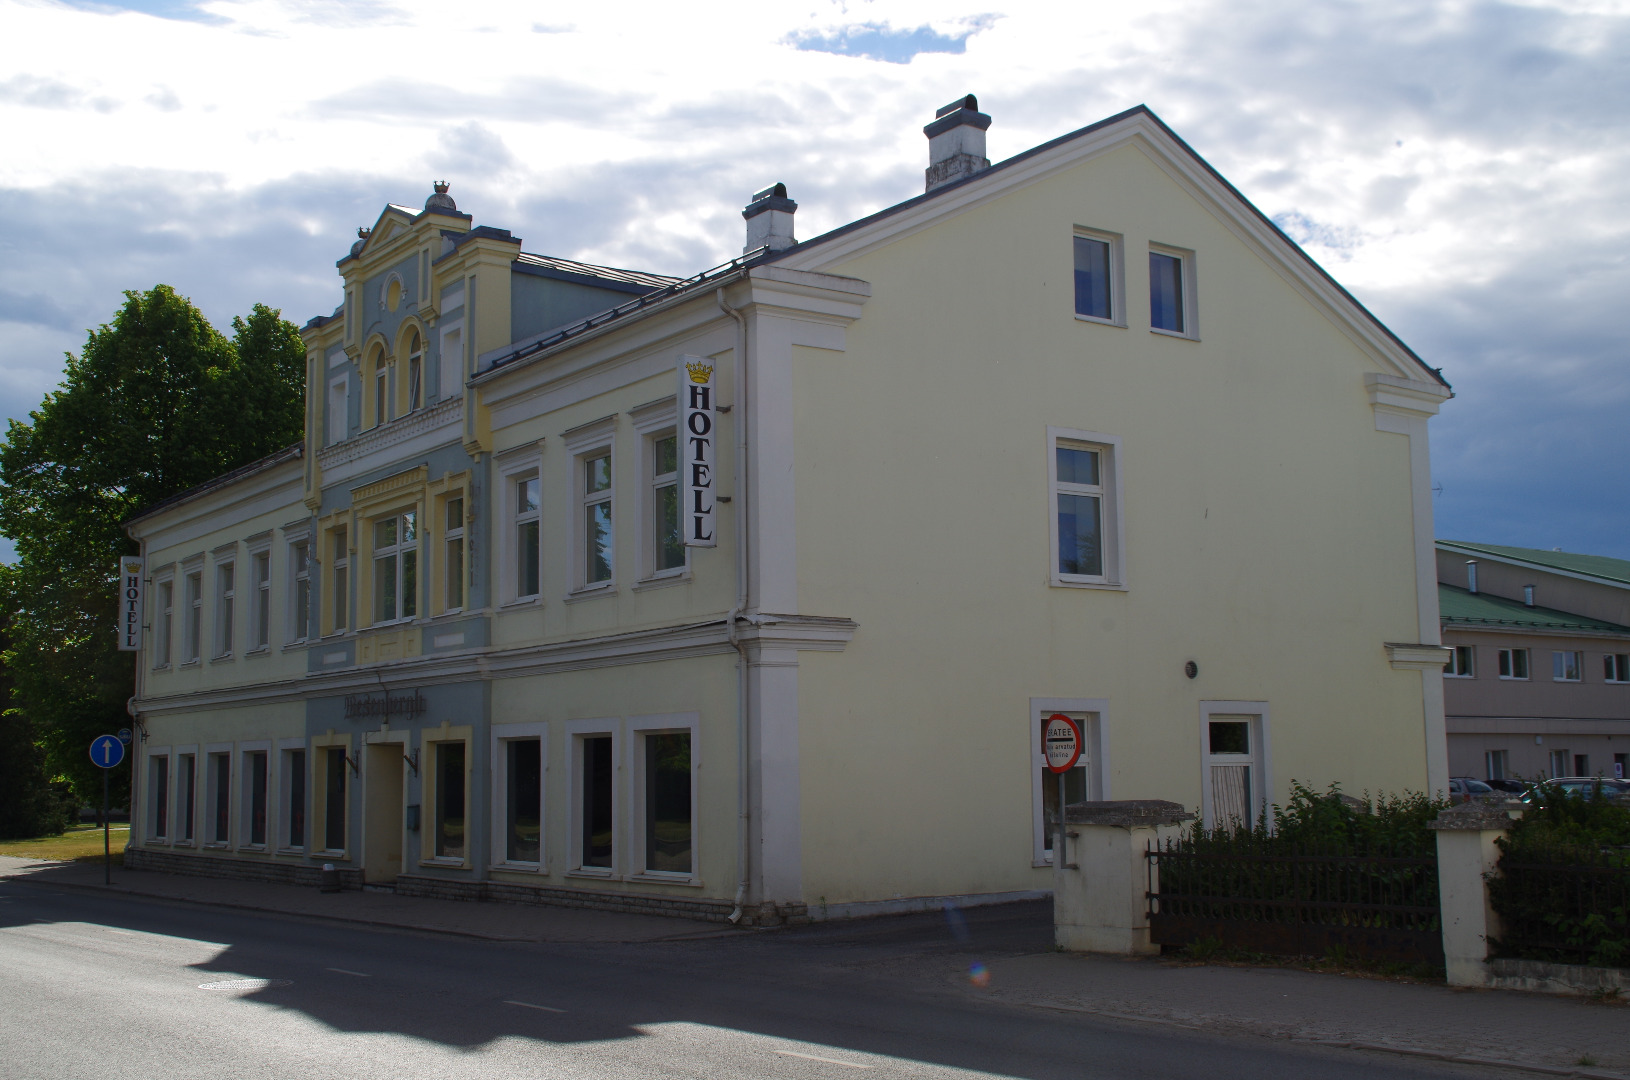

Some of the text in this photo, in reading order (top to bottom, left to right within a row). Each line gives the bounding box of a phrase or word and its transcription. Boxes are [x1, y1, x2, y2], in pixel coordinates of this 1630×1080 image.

[688, 385, 712, 540] HOTELL
[126, 576, 139, 647] HOTELL
[1048, 728, 1072, 736] ERATEE
